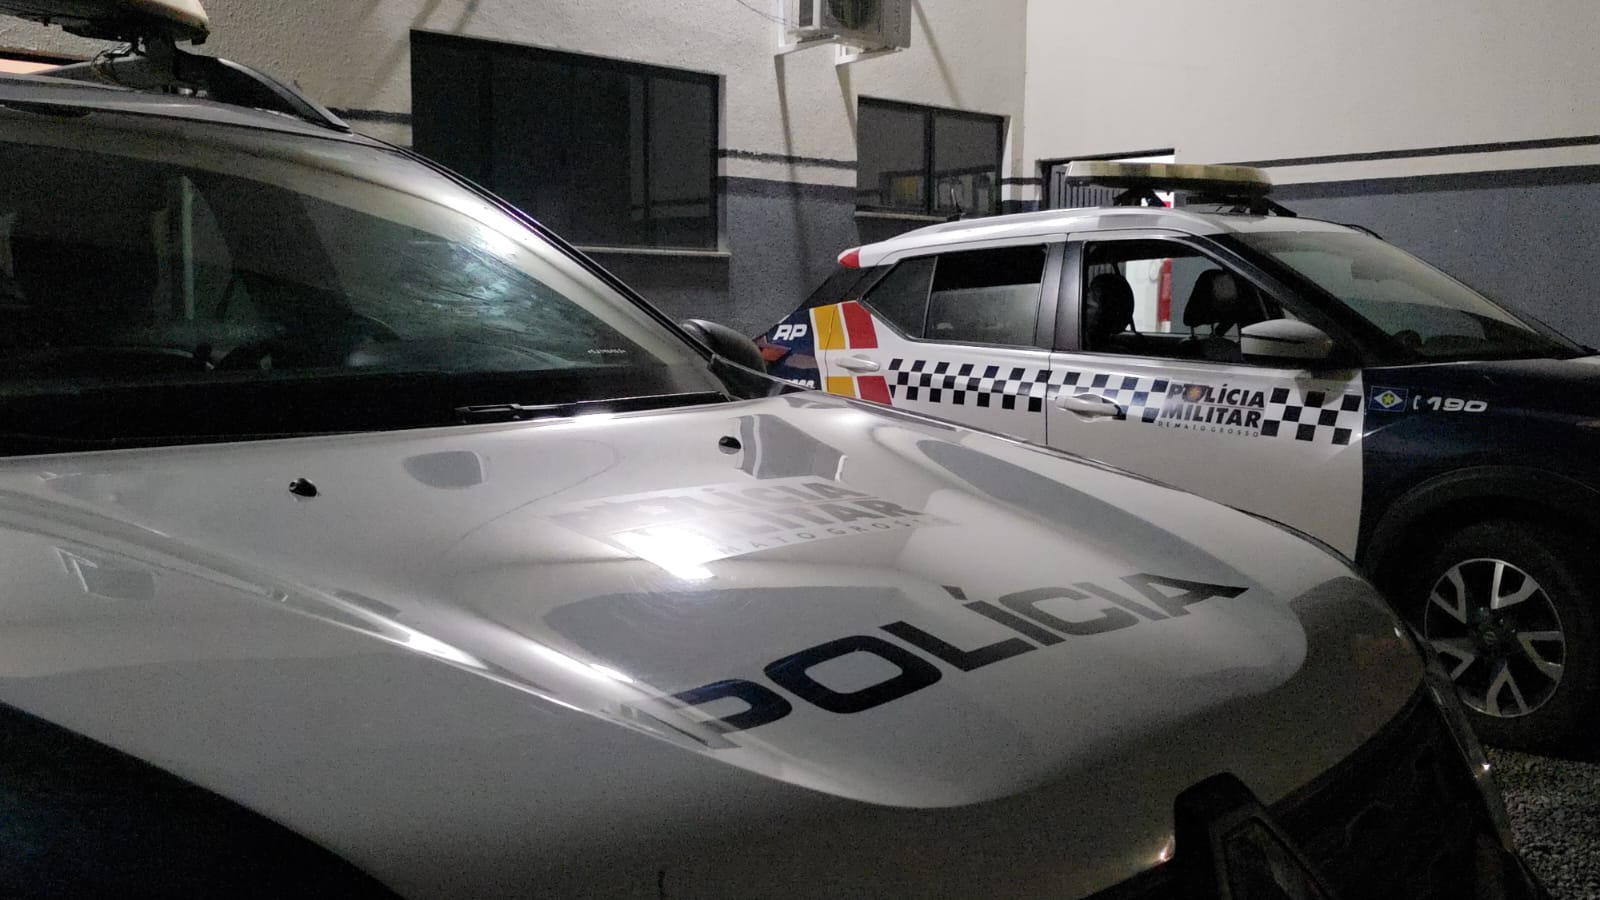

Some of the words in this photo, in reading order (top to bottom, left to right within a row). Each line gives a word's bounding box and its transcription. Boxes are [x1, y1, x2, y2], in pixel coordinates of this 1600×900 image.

[1160, 404, 1262, 429] MILITAR
[1426, 396, 1488, 412] 190
[655, 572, 1250, 750] POLÍCIA
